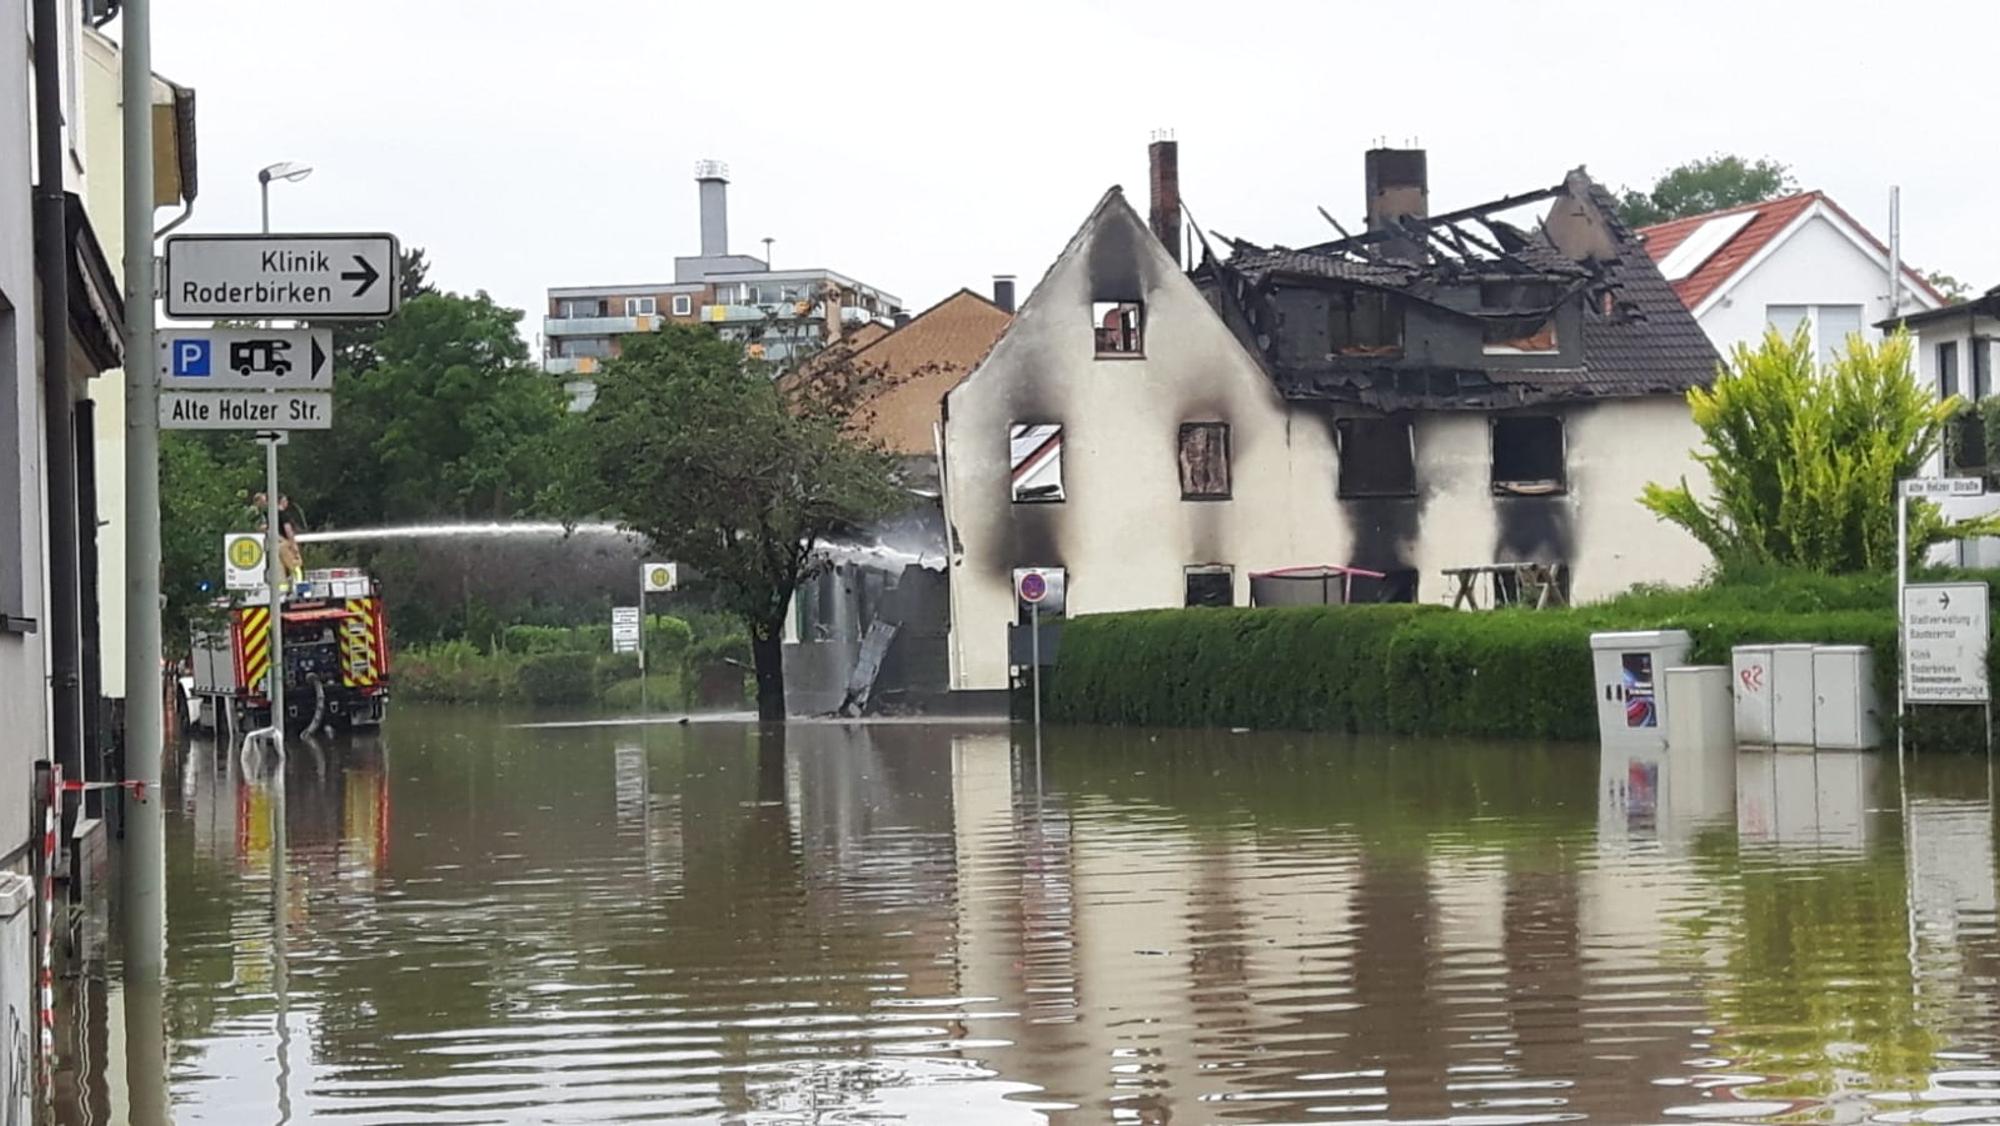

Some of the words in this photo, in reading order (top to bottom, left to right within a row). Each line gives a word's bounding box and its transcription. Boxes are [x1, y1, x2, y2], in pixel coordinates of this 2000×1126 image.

[262, 251, 330, 272] Klinik
[183, 282, 331, 303] Roderbirken
[181, 344, 202, 371] P
[173, 400, 209, 420] Alte
[220, 400, 278, 420] Holzer
[290, 400, 321, 420] Str.
[1908, 483, 1923, 492] Alte
[1954, 480, 1979, 491] Straße
